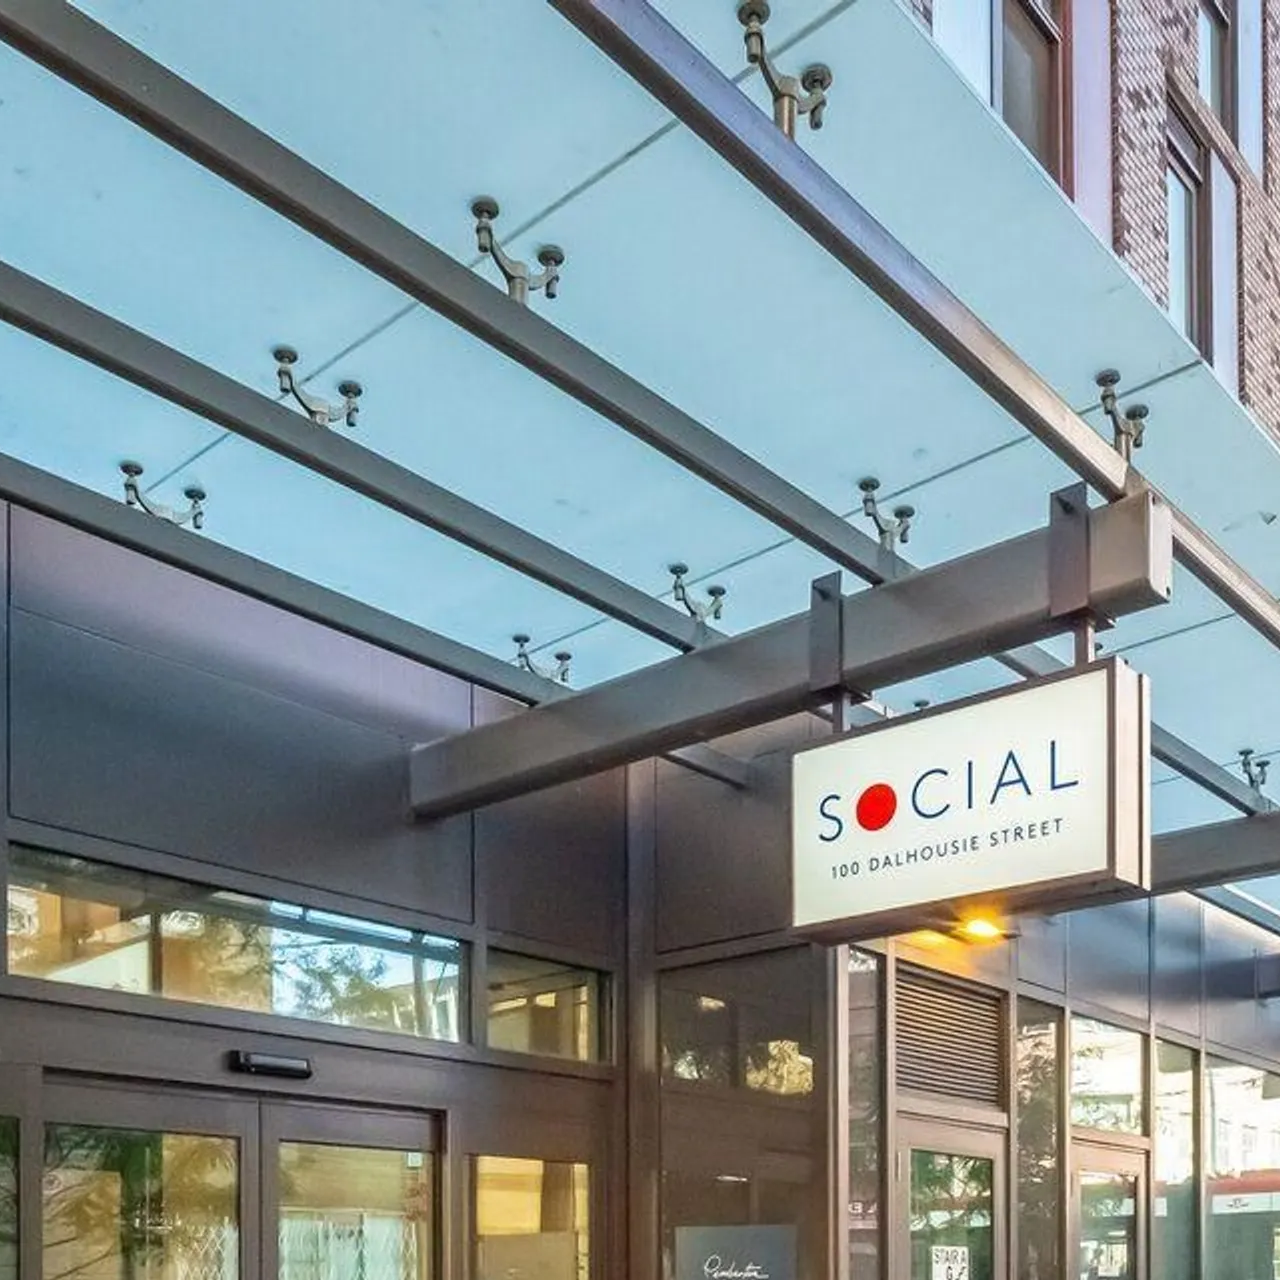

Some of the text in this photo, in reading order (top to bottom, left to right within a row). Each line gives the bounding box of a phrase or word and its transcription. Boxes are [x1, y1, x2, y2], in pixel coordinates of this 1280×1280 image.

[818, 739, 1080, 842] SOCIAL
[831, 817, 1063, 879] 100 DALHOUSIE STREET
